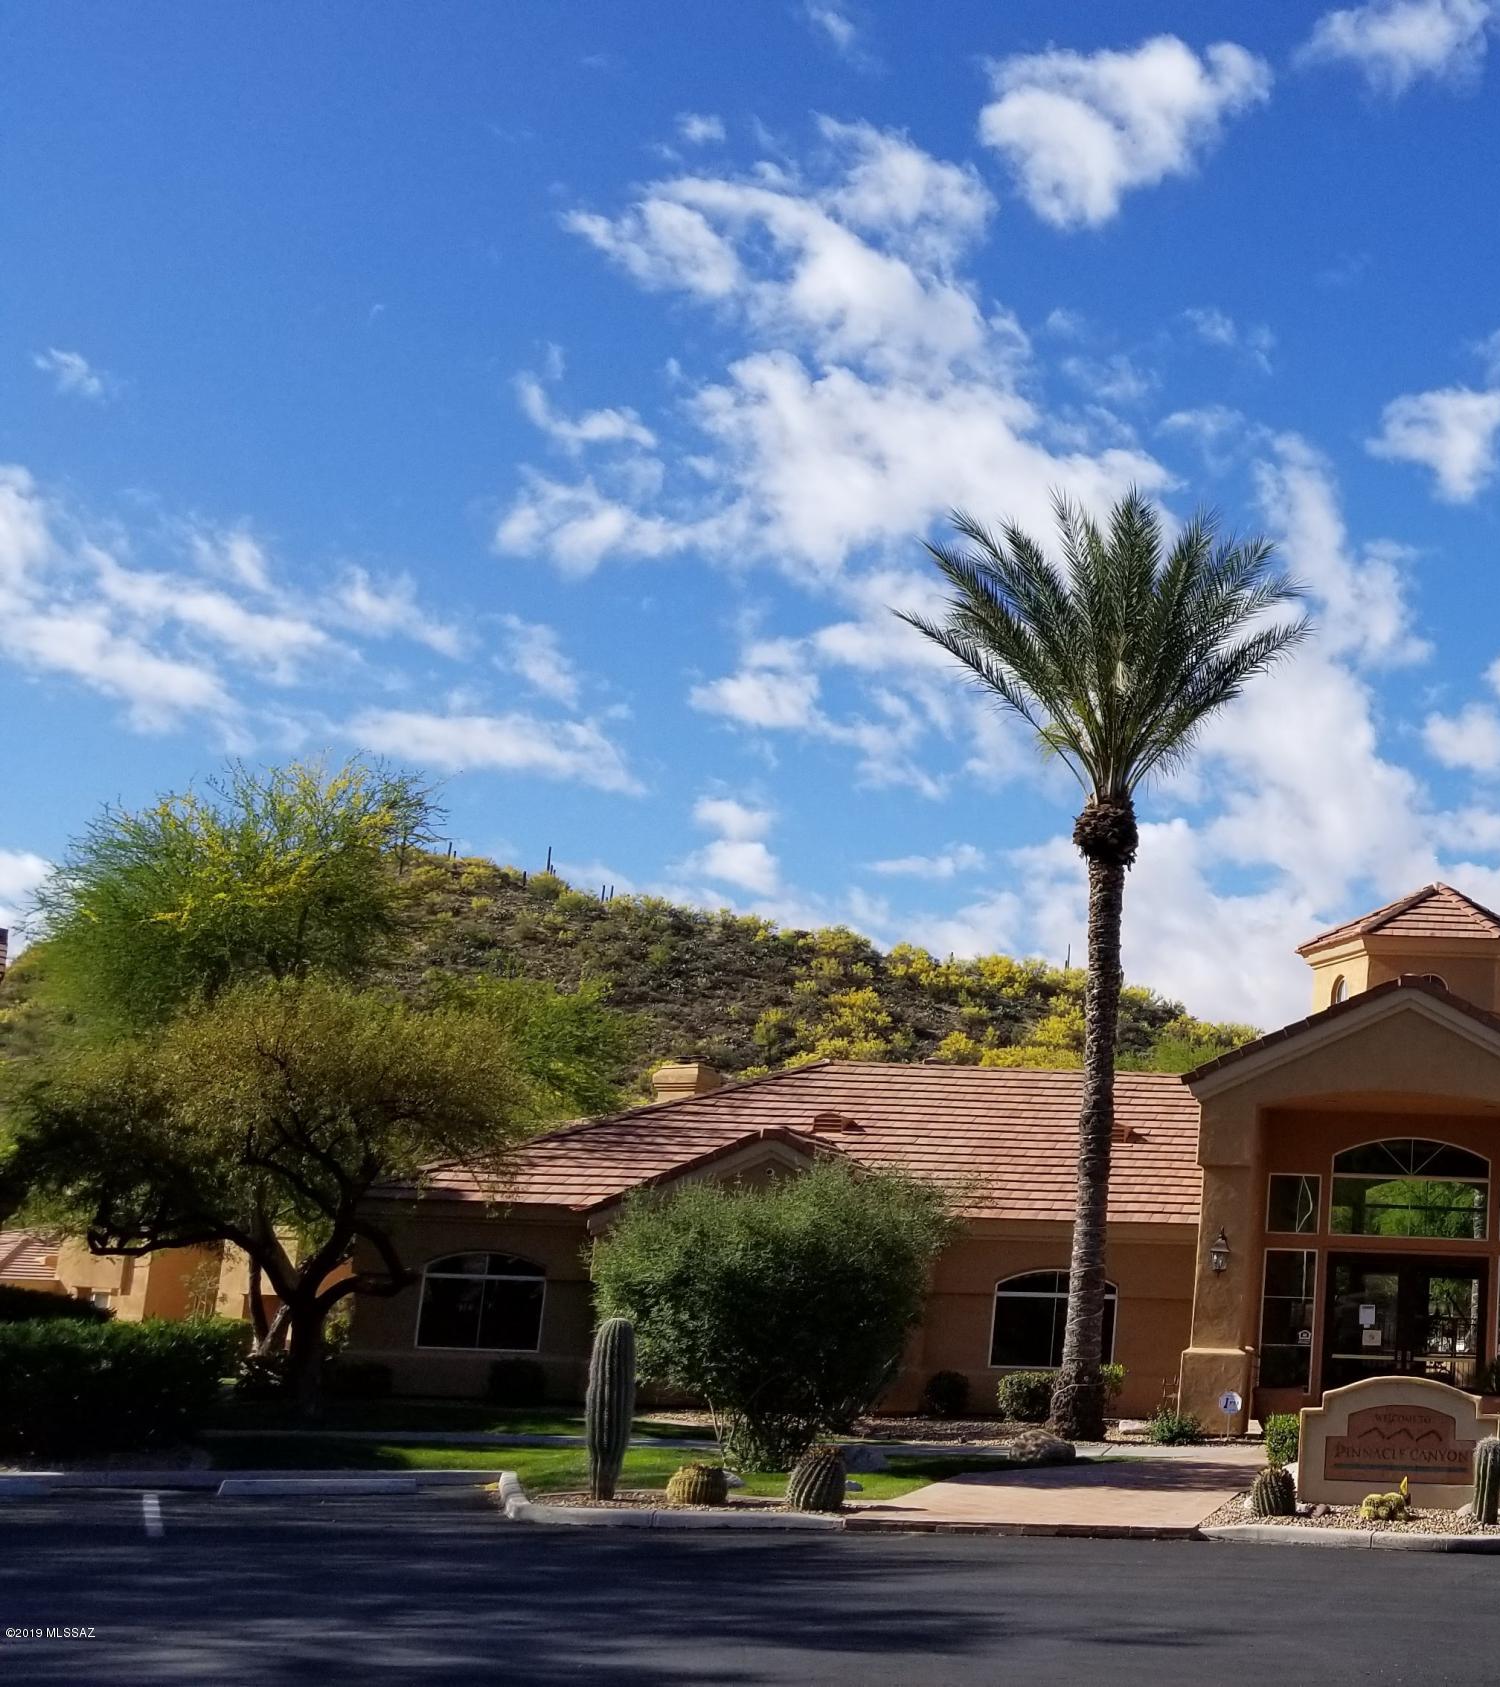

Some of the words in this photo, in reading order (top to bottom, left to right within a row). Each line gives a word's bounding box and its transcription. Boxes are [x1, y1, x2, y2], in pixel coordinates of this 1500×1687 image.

[1375, 1413, 1417, 1423] WELCOME
[1334, 1441, 1407, 1460] PINNACLE
[1409, 1446, 1469, 1463] CANYON
